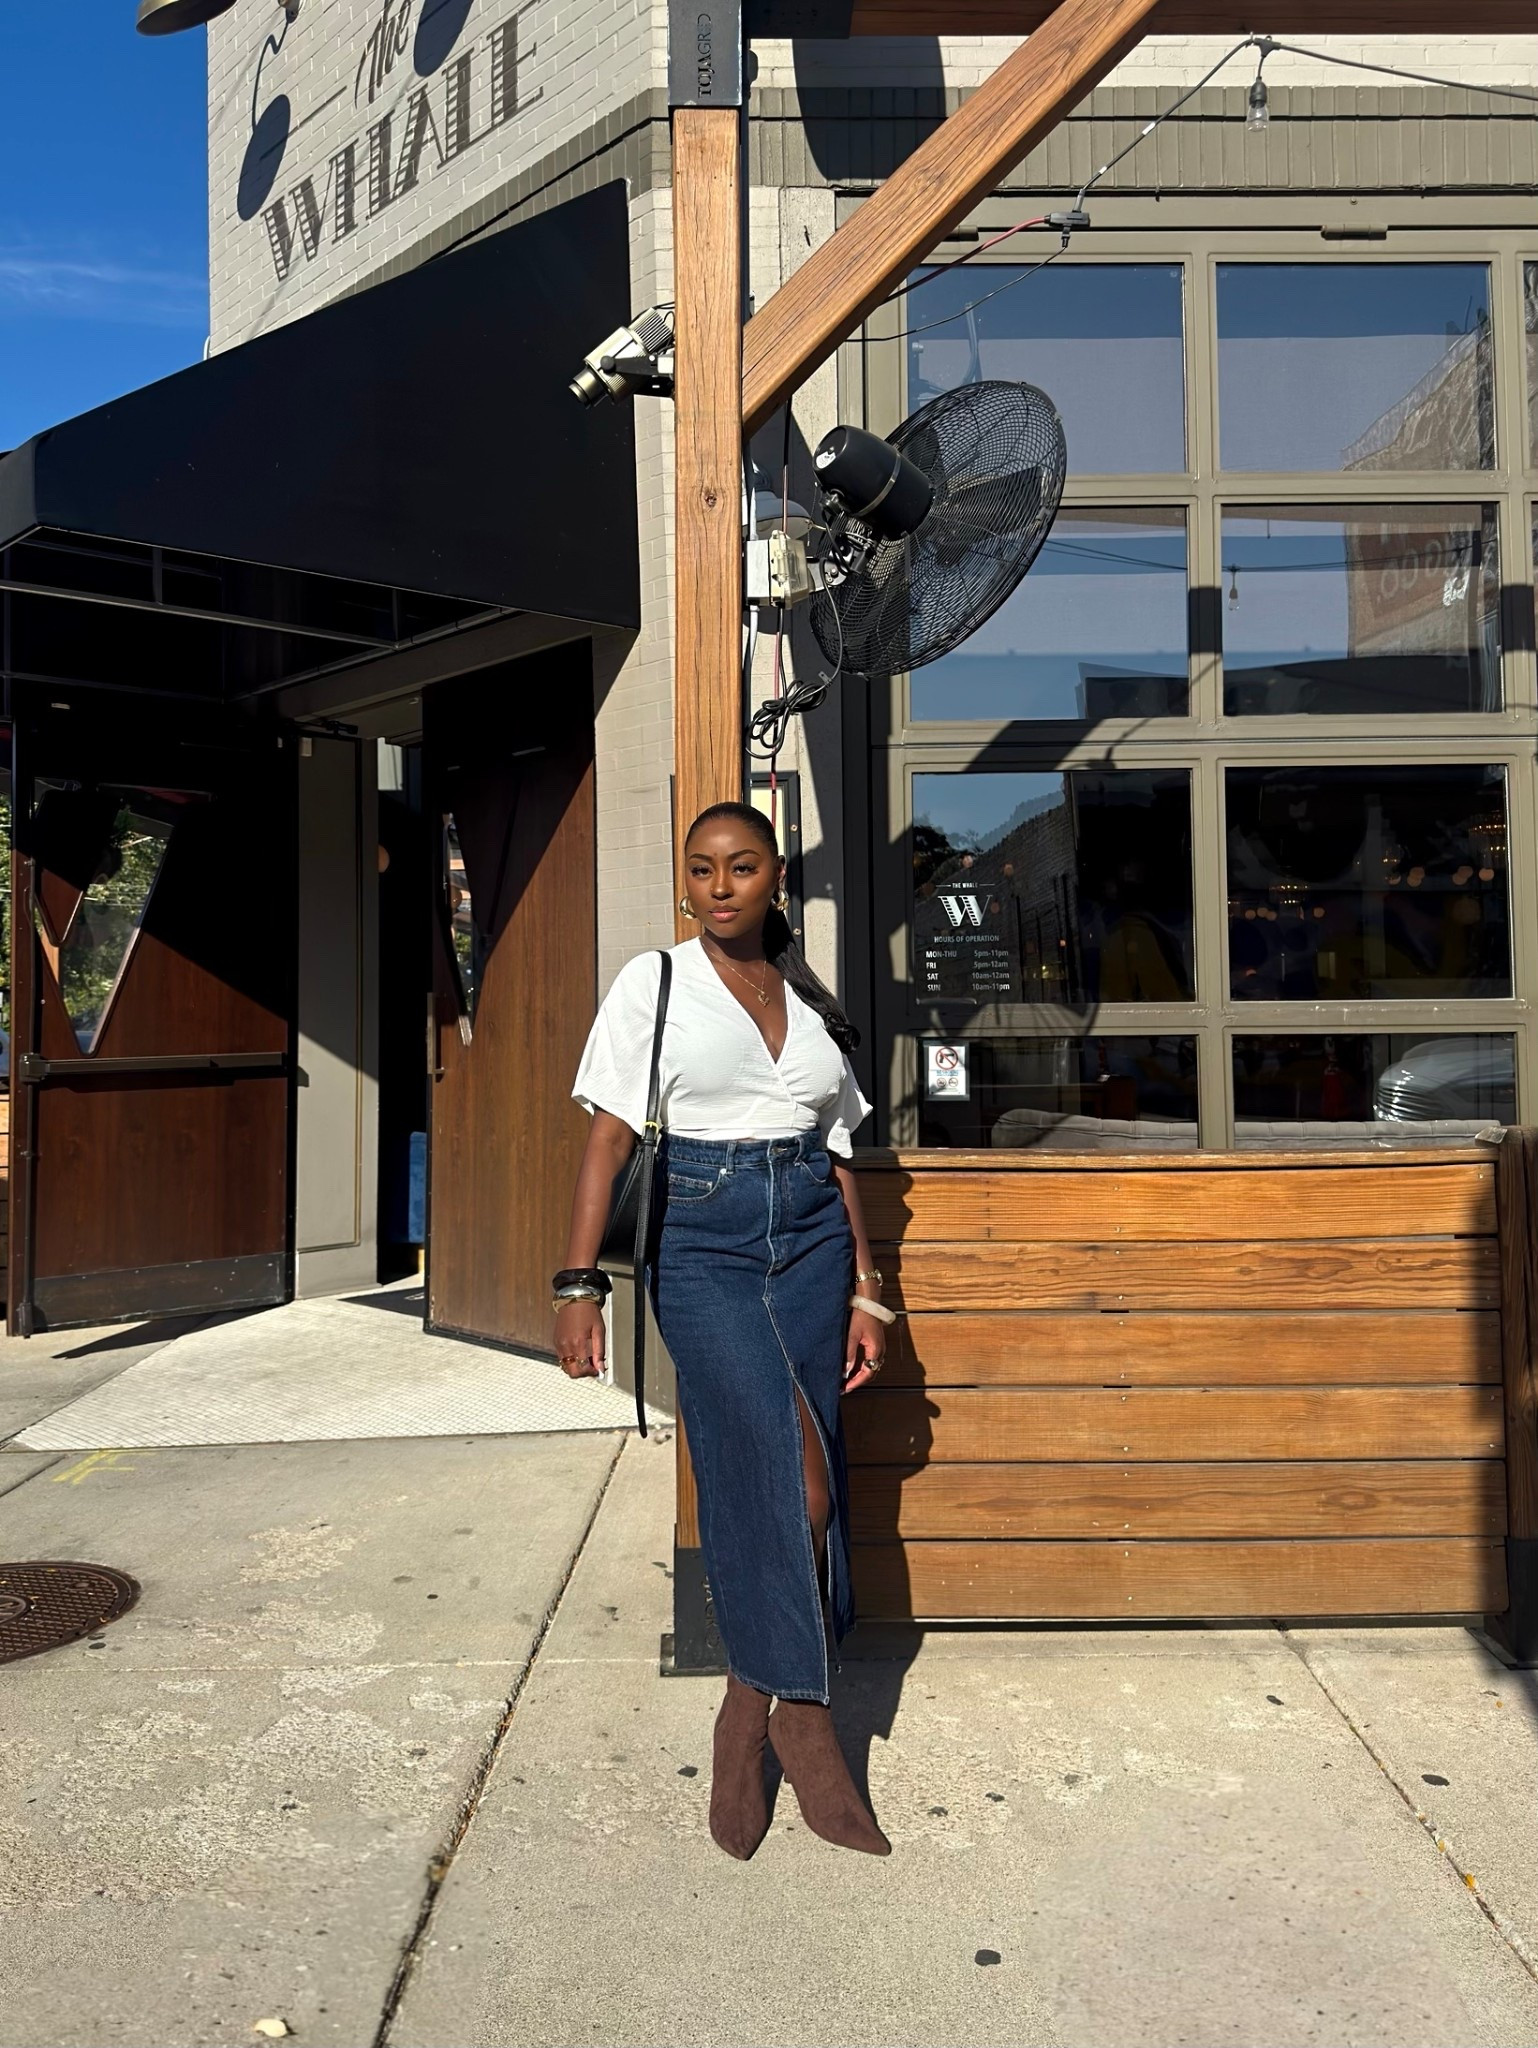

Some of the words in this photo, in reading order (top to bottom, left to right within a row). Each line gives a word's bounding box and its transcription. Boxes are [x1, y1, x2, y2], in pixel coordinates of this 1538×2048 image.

[261, 13, 543, 282] WHALE
[937, 894, 993, 926] W
[934, 935, 955, 943] HOURS
[956, 935, 964, 943] OF
[965, 934, 1000, 942] OPERATION
[925, 950, 957, 958] MON-THU
[974, 950, 1009, 958] 5pm-11pm
[974, 961, 1009, 969] 5pm-12am
[927, 984, 941, 992] SUN
[972, 983, 1010, 991] 10am-11pm
